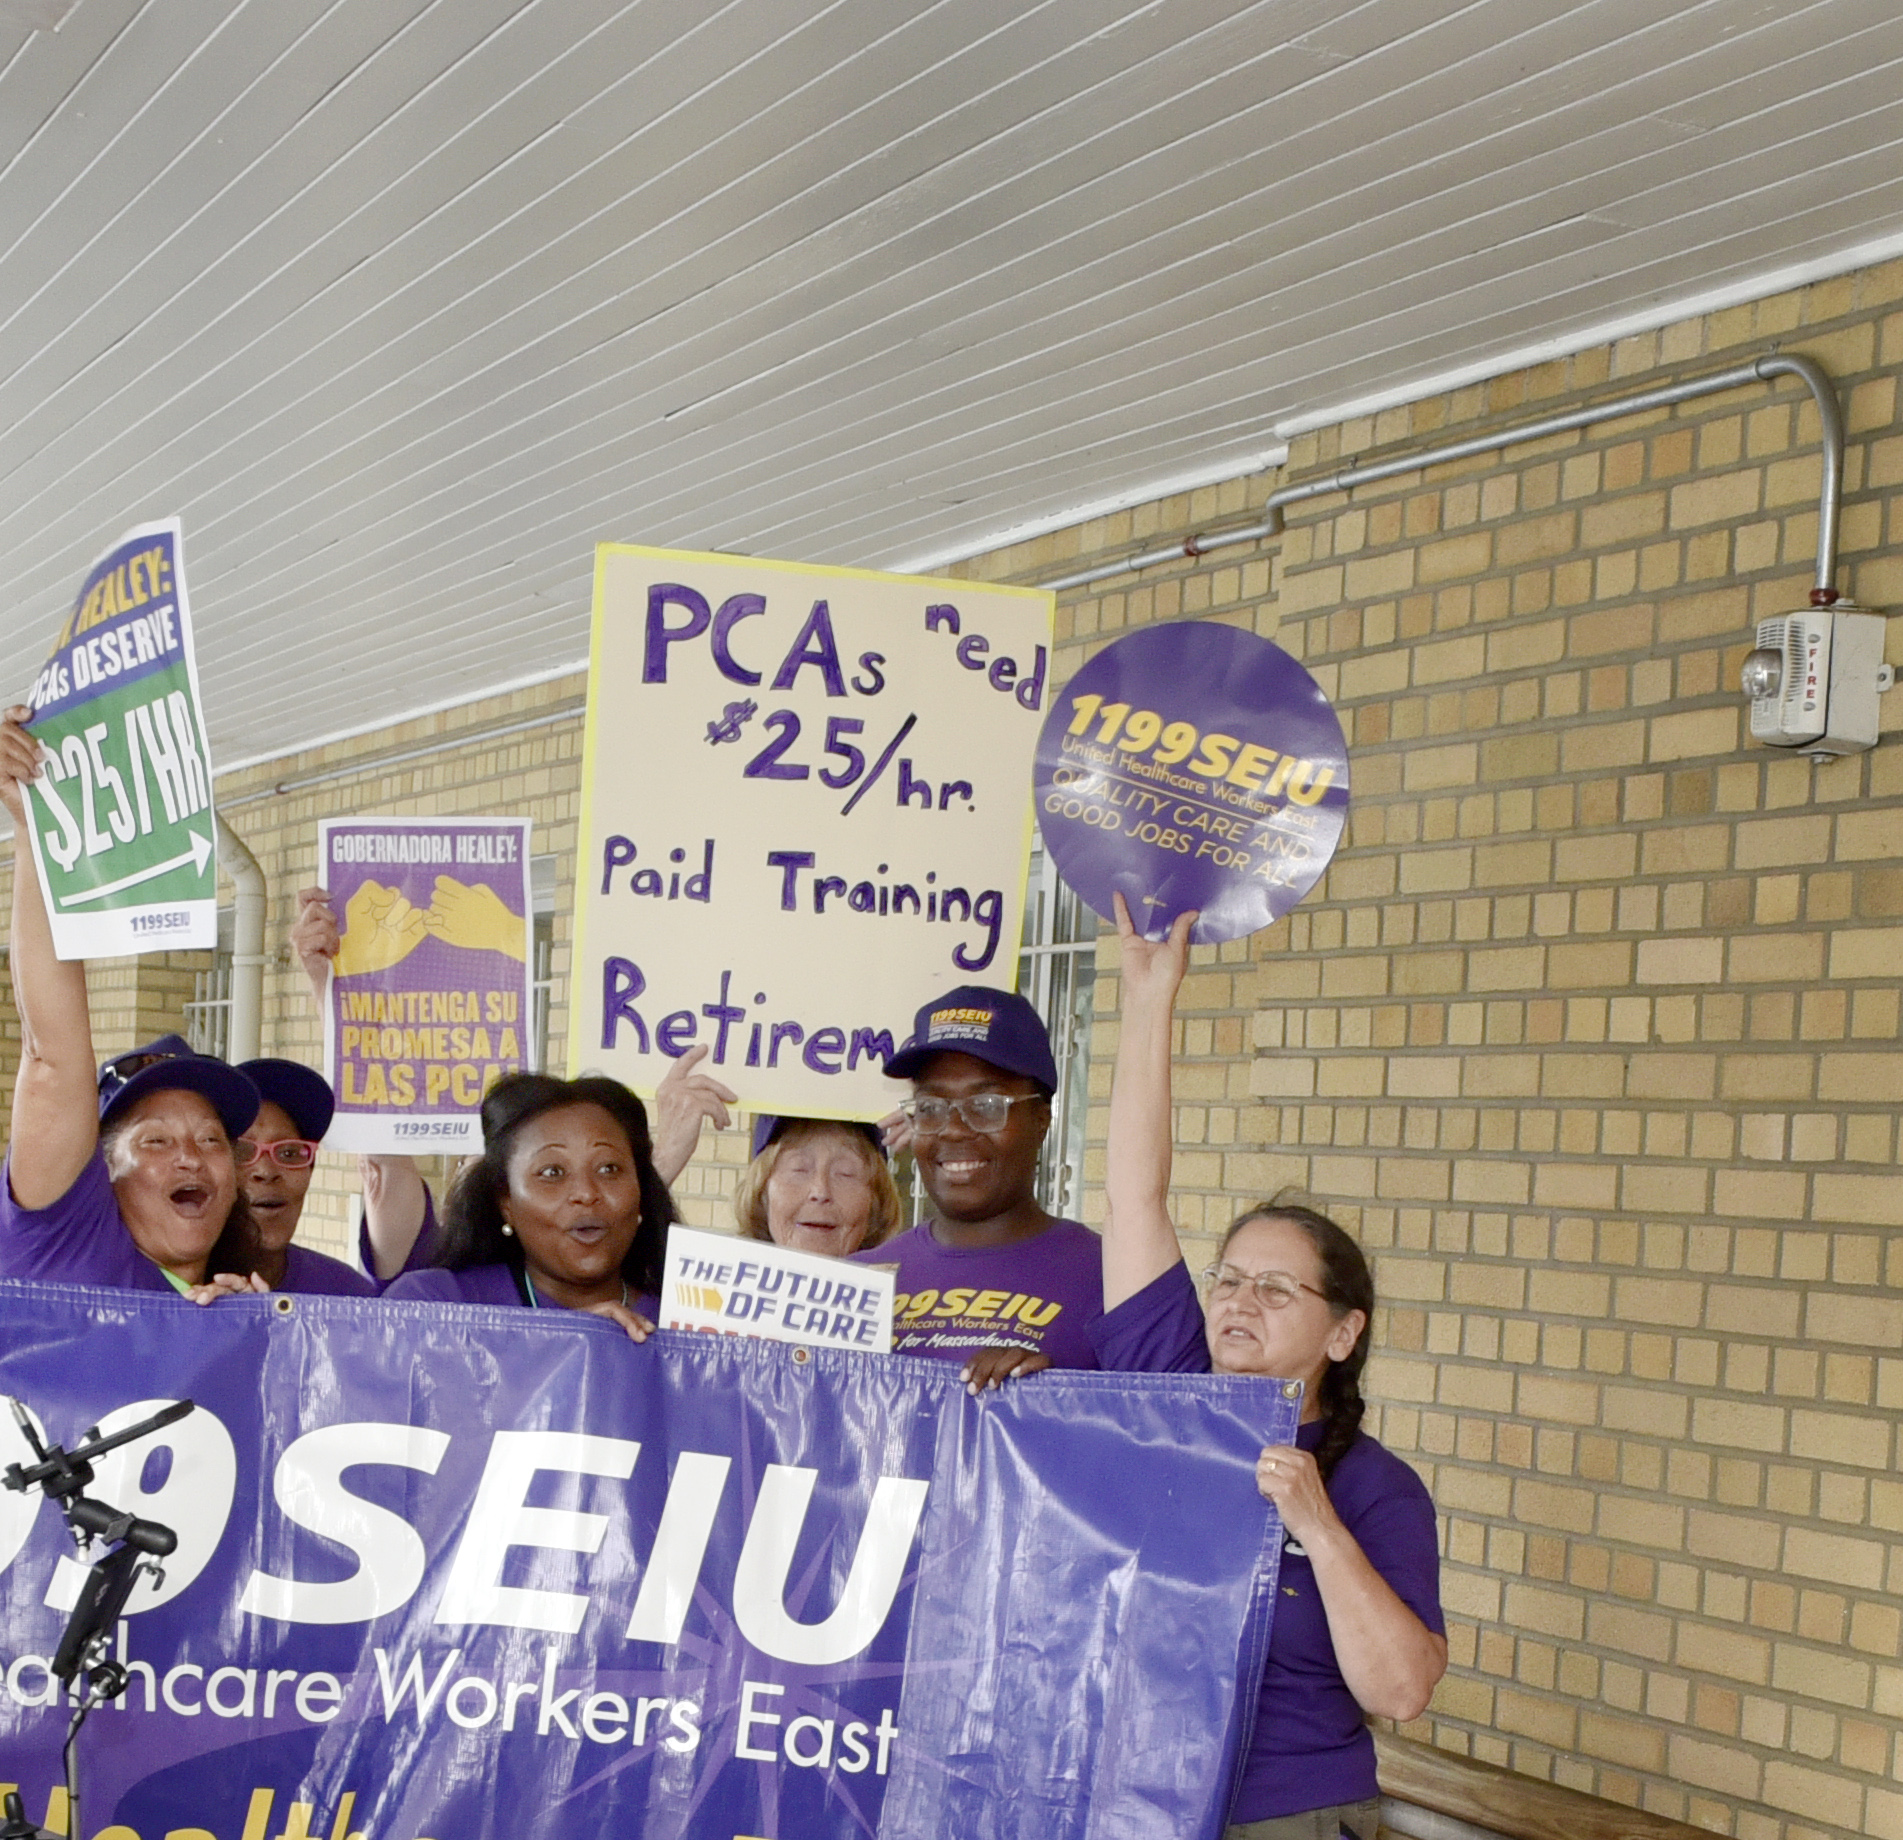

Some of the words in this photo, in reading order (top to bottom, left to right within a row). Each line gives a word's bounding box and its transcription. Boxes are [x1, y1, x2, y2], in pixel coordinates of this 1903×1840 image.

[26, 661, 70, 711] PCAs
[71, 603, 179, 691] DESERVE
[641, 582, 887, 698] PCAs
[924, 602, 1047, 712] need
[1806, 647, 1818, 699] FIRE
[703, 697, 976, 817] $25/hr.
[1067, 693, 1336, 808] 1199SEIU
[34, 689, 209, 874] $25/HR
[1060, 735, 1117, 767] United
[1118, 750, 1208, 796] Healthcare
[1212, 781, 1280, 817] Workers
[1282, 804, 1319, 829] East
[1044, 792, 1122, 832] GOOD
[1124, 818, 1195, 855] JOBS
[1194, 840, 1252, 872] FOR
[1252, 860, 1299, 890] ALL
[1051, 767, 1173, 818] QUALITY
[1172, 805, 1250, 844] CARE
[1248, 831, 1314, 863] AND
[332, 834, 452, 865] GOBERNADORA
[456, 834, 518, 864] HEALEY:
[130, 911, 192, 932] 1199SEIU
[600, 834, 716, 904] Paid
[766, 850, 1004, 973] Training
[340, 989, 481, 1024] ¡MANTENGA
[485, 989, 519, 1024] SU
[600, 955, 916, 1076] Retirem
[930, 1008, 993, 1023] 1199SEIU
[341, 1025, 493, 1061] PROMESA
[497, 1027, 520, 1060] A
[341, 1061, 416, 1108] LAS
[392, 1121, 470, 1136] 1199SEIU
[678, 1256, 733, 1285] THE
[732, 1260, 884, 1316] FUTURE
[724, 1291, 779, 1323] OF
[781, 1301, 881, 1347] CARE
[896, 1332, 926, 1351] for
[951, 1317, 1010, 1332] Workers
[1012, 1322, 1045, 1341] East
[372, 1647, 701, 1753] Workers
[734, 1680, 900, 1776] East
